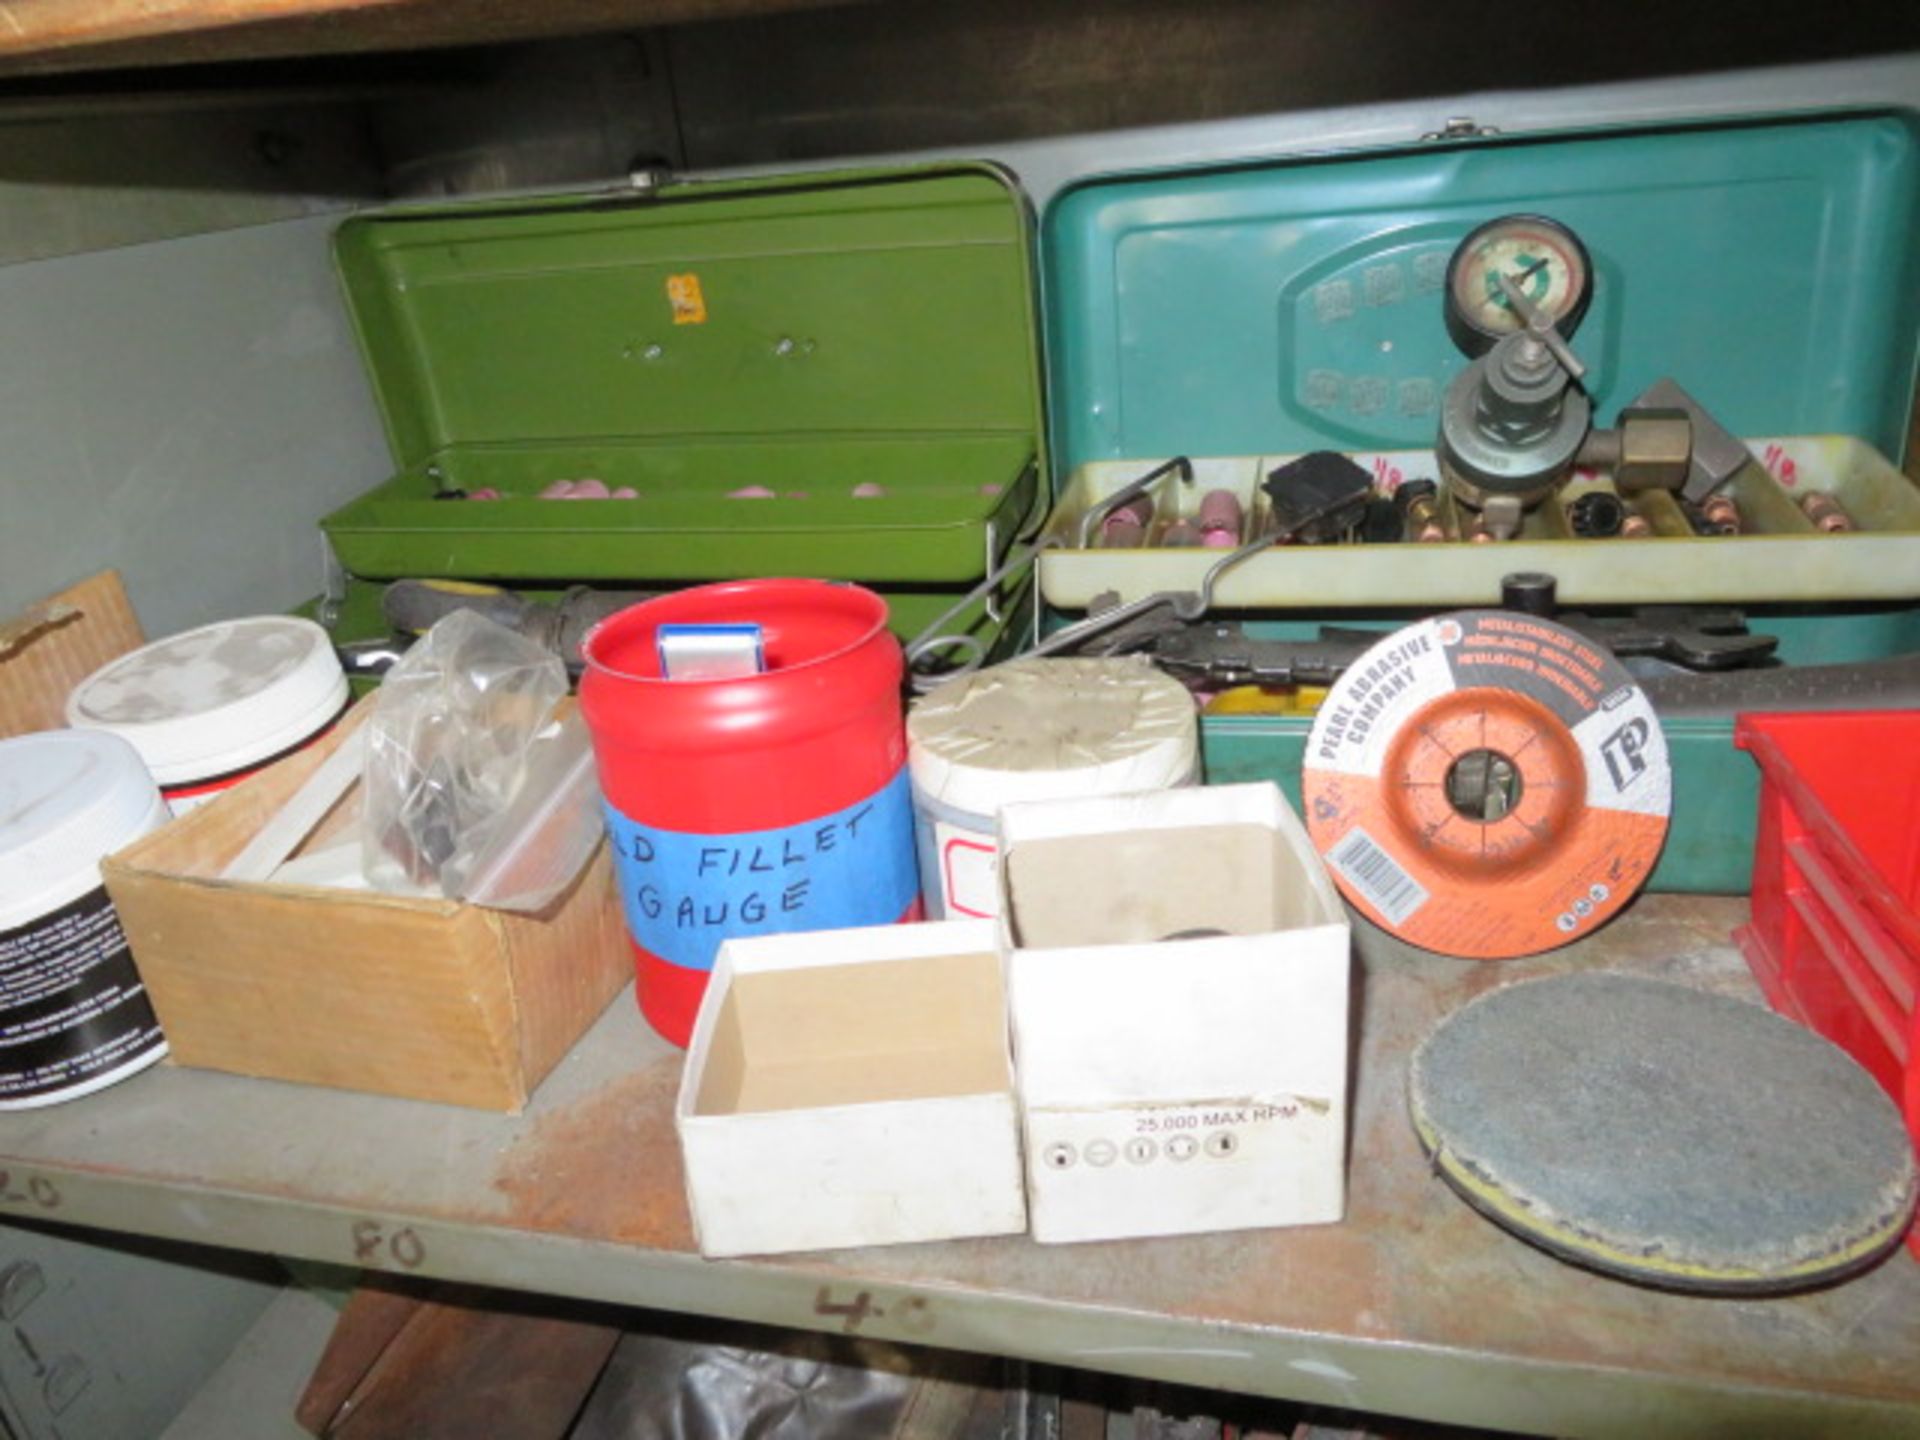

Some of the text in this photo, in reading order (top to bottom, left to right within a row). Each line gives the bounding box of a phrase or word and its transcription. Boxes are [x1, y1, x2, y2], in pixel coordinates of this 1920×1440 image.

[1319, 705, 1354, 759] PEARL
[1347, 635, 1431, 702] ABRASIVE
[1346, 665, 1416, 745] COMPANY
[698, 803, 874, 877] FILLET
[637, 879, 811, 929] GAUGE
[1202, 1109, 1248, 1127] MAX
[1253, 1105, 1298, 1122] RPM
